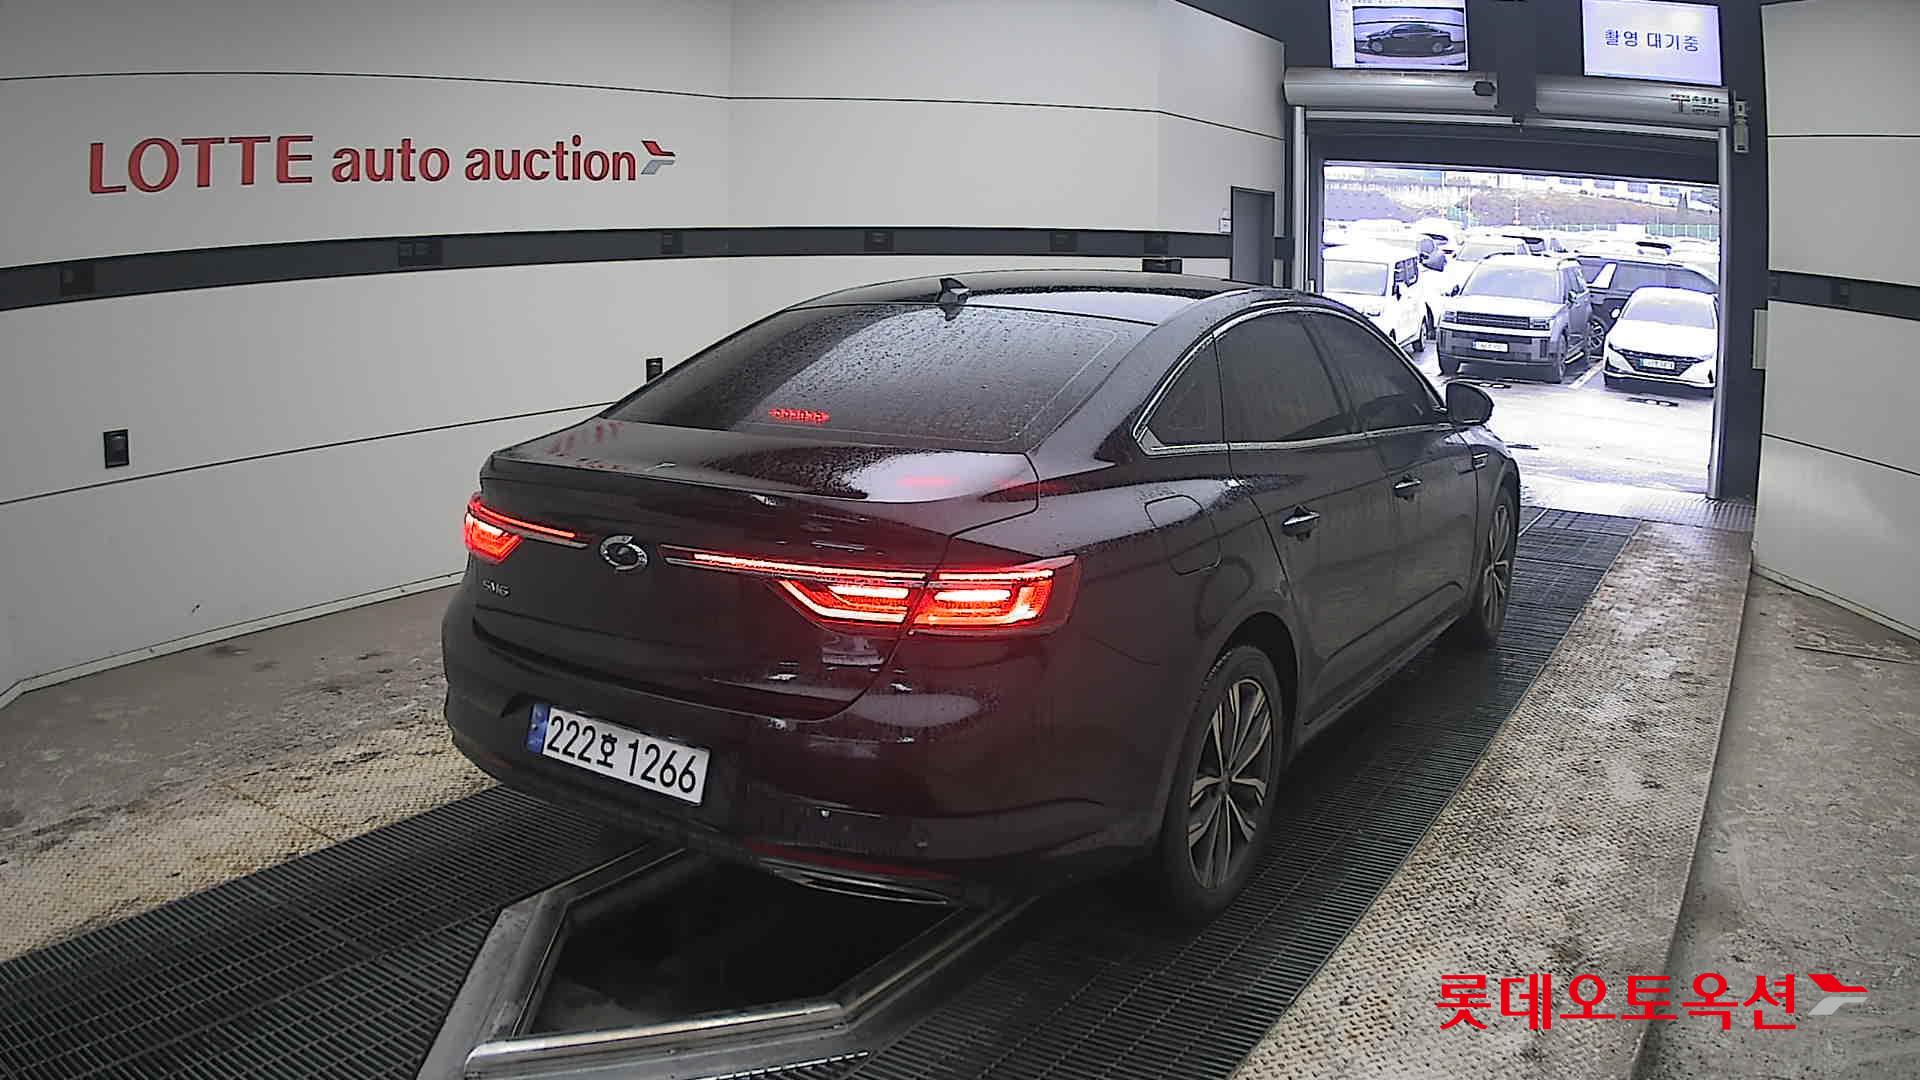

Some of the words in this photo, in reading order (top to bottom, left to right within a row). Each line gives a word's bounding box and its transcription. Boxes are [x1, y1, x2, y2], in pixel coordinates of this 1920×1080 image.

[1605, 29, 1638, 47] 촬영
[1647, 32, 1699, 52] 대기중
[88, 134, 314, 194] LOTTE
[331, 137, 450, 182] auto
[463, 134, 638, 182] auction
[546, 715, 618, 769] 222호
[627, 738, 697, 794] 1266
